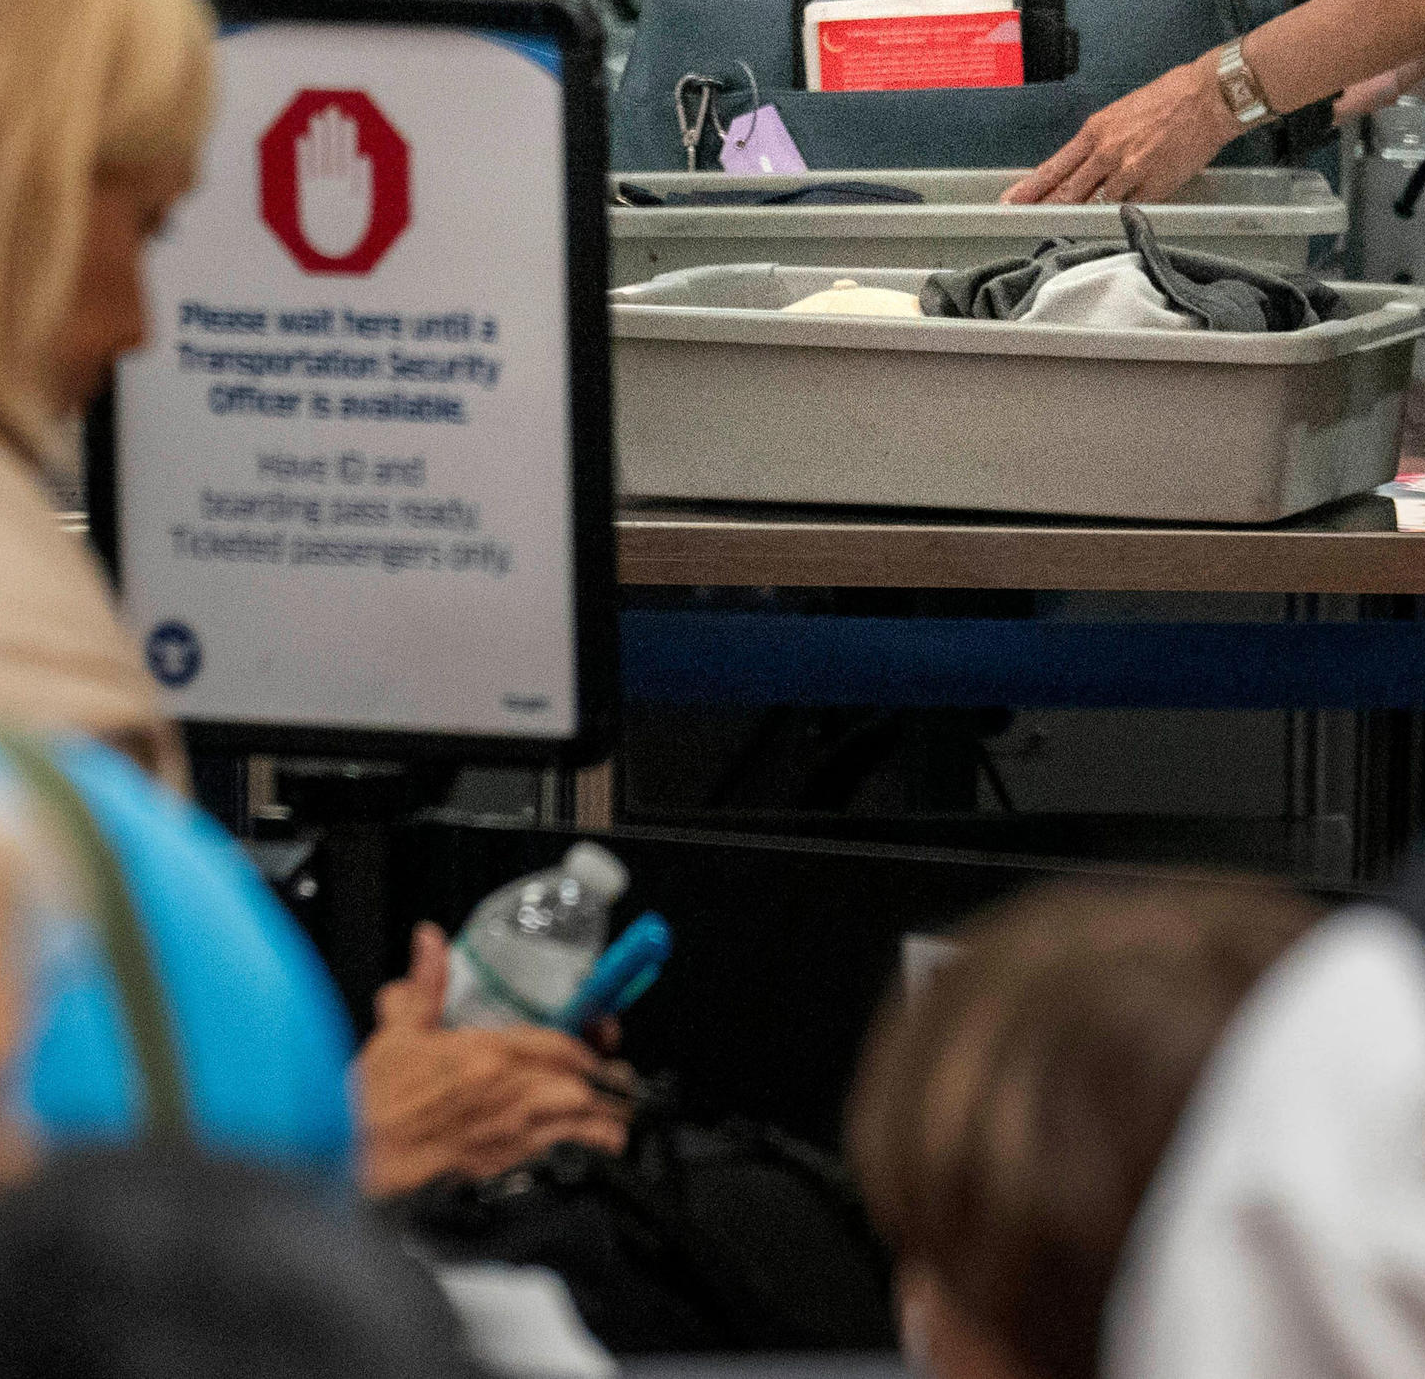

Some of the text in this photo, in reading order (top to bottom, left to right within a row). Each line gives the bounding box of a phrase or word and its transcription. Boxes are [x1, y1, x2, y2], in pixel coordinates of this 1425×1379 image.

[178, 302, 499, 343] Please wait here until a
[177, 341, 501, 391] Transportation Security
[209, 383, 300, 417] Officer
[312, 391, 330, 418] is
[257, 451, 425, 488] Have ID and
[201, 485, 320, 526] boarding
[331, 498, 388, 528] pass
[170, 524, 283, 563] Ticketed
[291, 534, 441, 573] passengers
